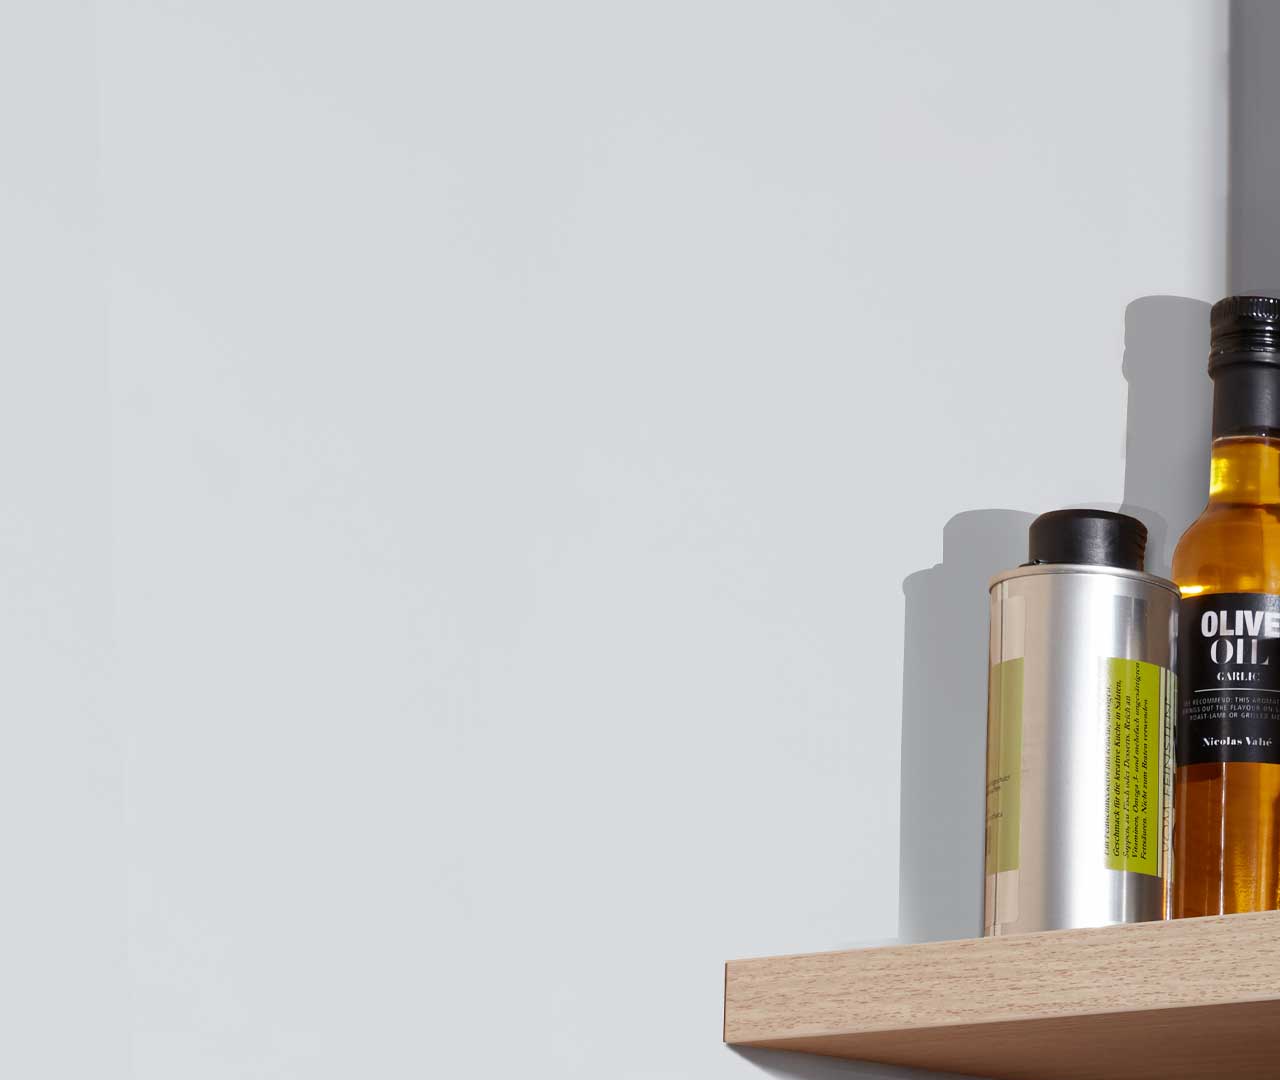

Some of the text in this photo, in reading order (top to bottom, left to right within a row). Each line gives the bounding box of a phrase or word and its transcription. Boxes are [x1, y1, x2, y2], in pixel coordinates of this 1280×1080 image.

[1201, 610, 1280, 638] OLIVE
[1210, 638, 1269, 665] OIL
[1216, 671, 1260, 681] GARLIC
[1202, 736, 1272, 747] Nicolas Vahé
